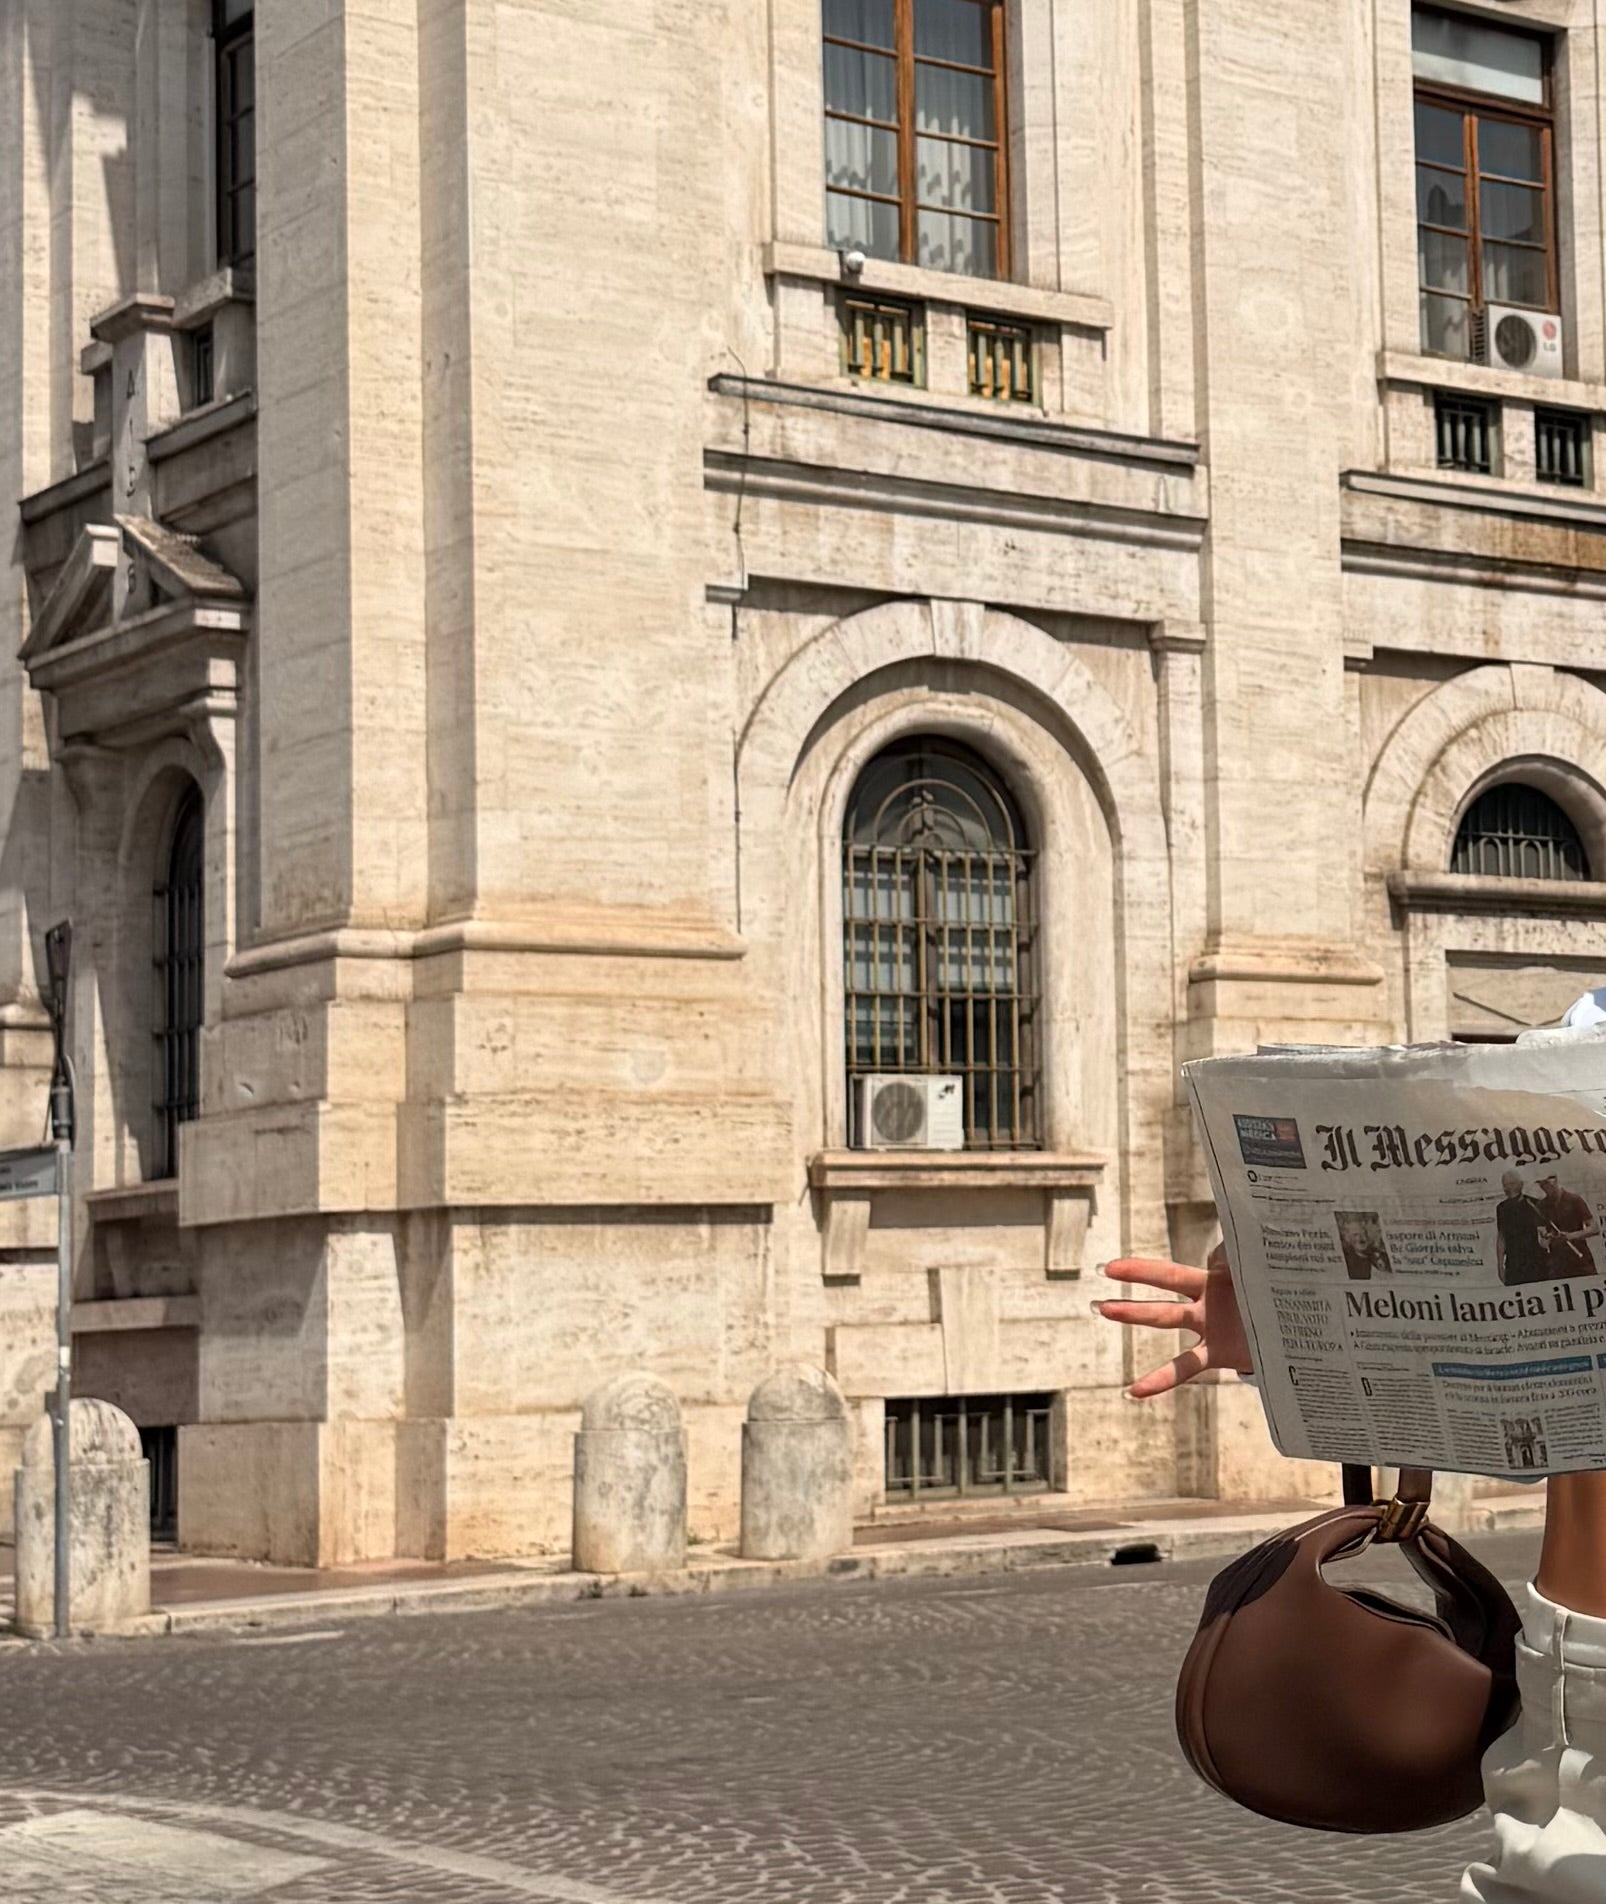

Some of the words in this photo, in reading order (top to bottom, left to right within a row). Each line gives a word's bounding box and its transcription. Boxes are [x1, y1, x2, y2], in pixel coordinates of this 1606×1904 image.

[1315, 1124, 1362, 1172] Il
[1344, 1289, 1444, 1322] Meloni
[1449, 1291, 1547, 1323] lancia
[1553, 1283, 1576, 1313] il
